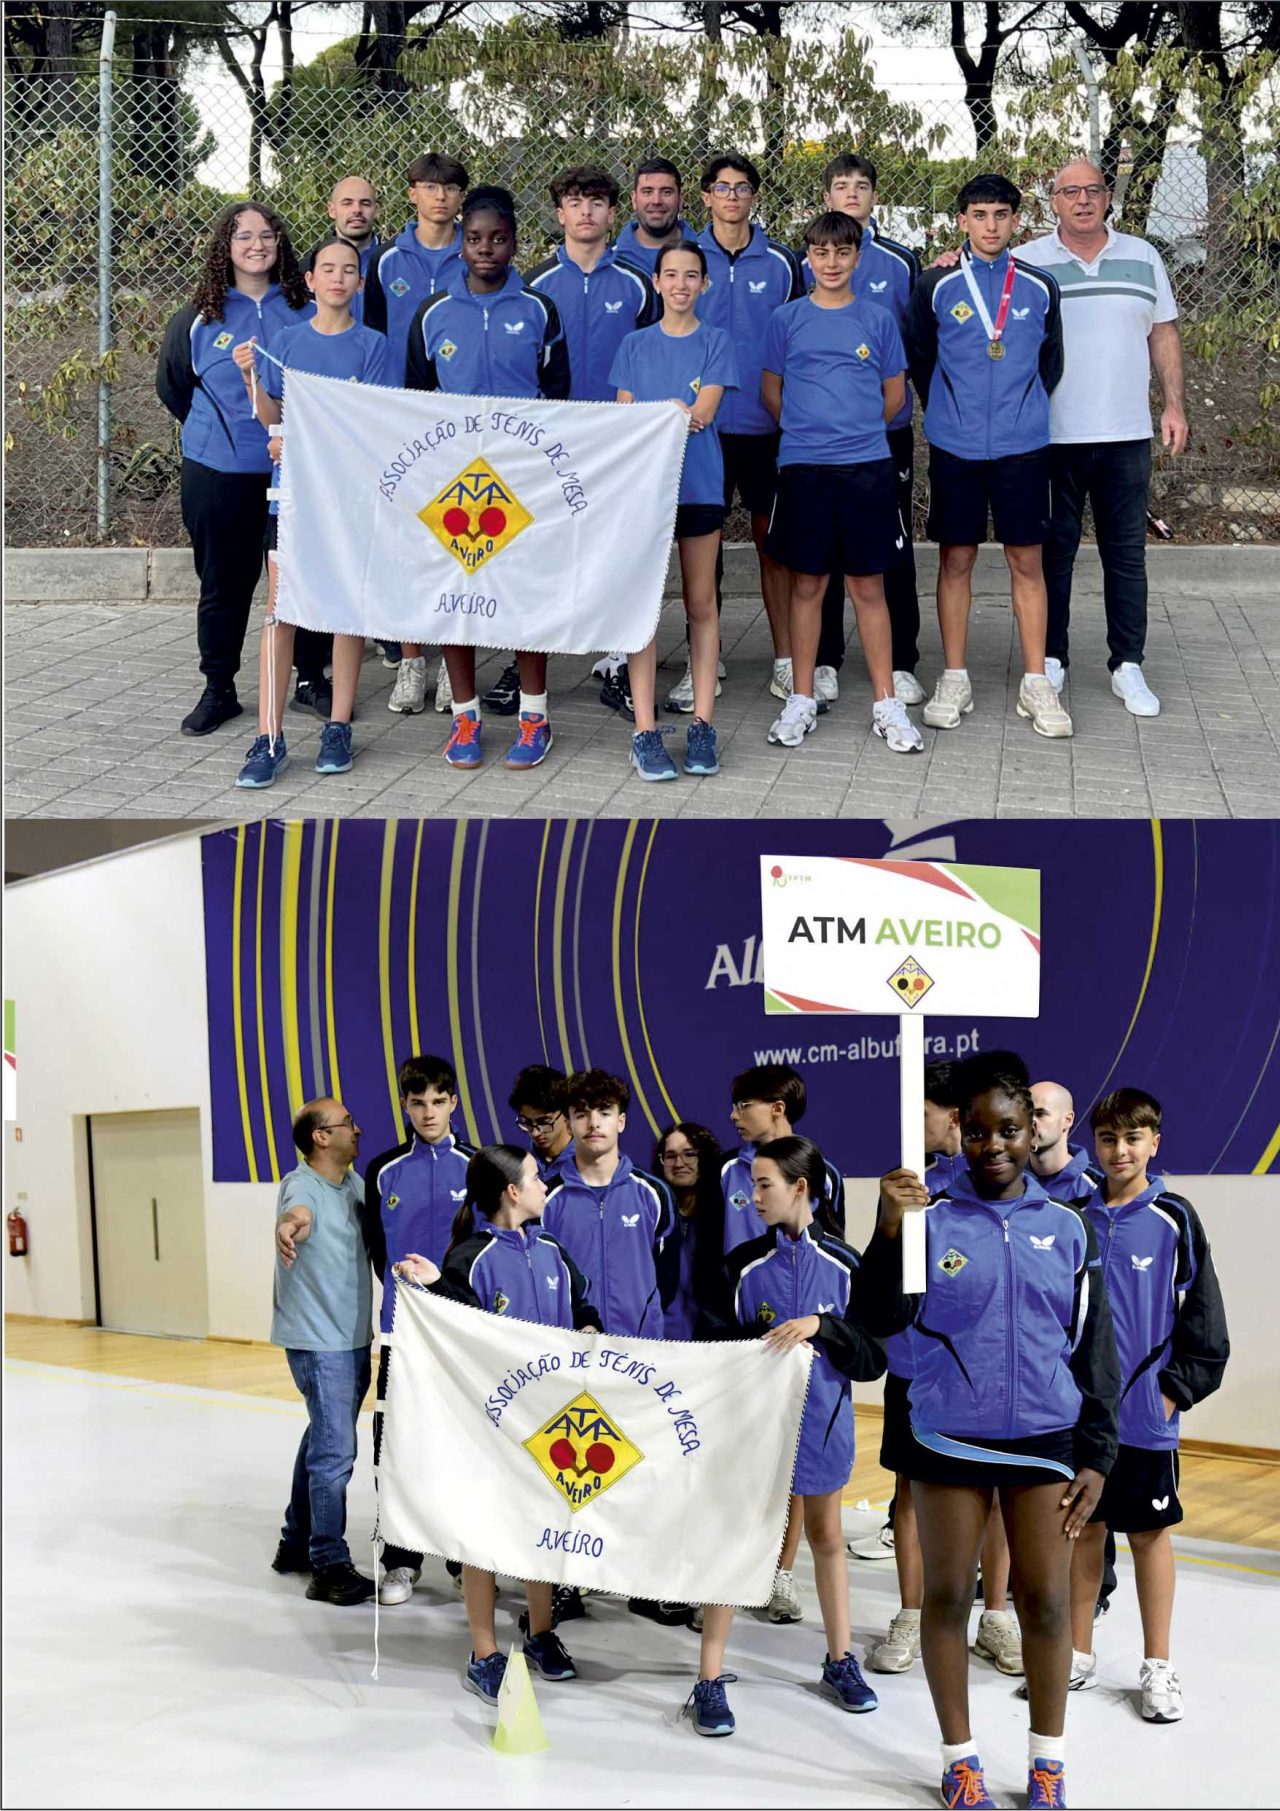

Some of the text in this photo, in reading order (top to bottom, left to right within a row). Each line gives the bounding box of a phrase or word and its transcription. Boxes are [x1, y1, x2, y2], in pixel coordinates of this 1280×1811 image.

[379, 412, 588, 516] ASSOCIAÇÃO DE TÉNIS DE MESA
[450, 538, 494, 567] AVEIRO
[434, 592, 497, 619] AVEIRO
[787, 916, 1002, 950] ATM AVEIRO
[754, 1028, 980, 1067] www.cm-albufra.pt
[485, 1349, 701, 1456] ASSOCIAÇÃO DE TÉNIS DE MESA
[556, 1471, 601, 1504] AVEIRO
[536, 1527, 604, 1558] AVEIRO
